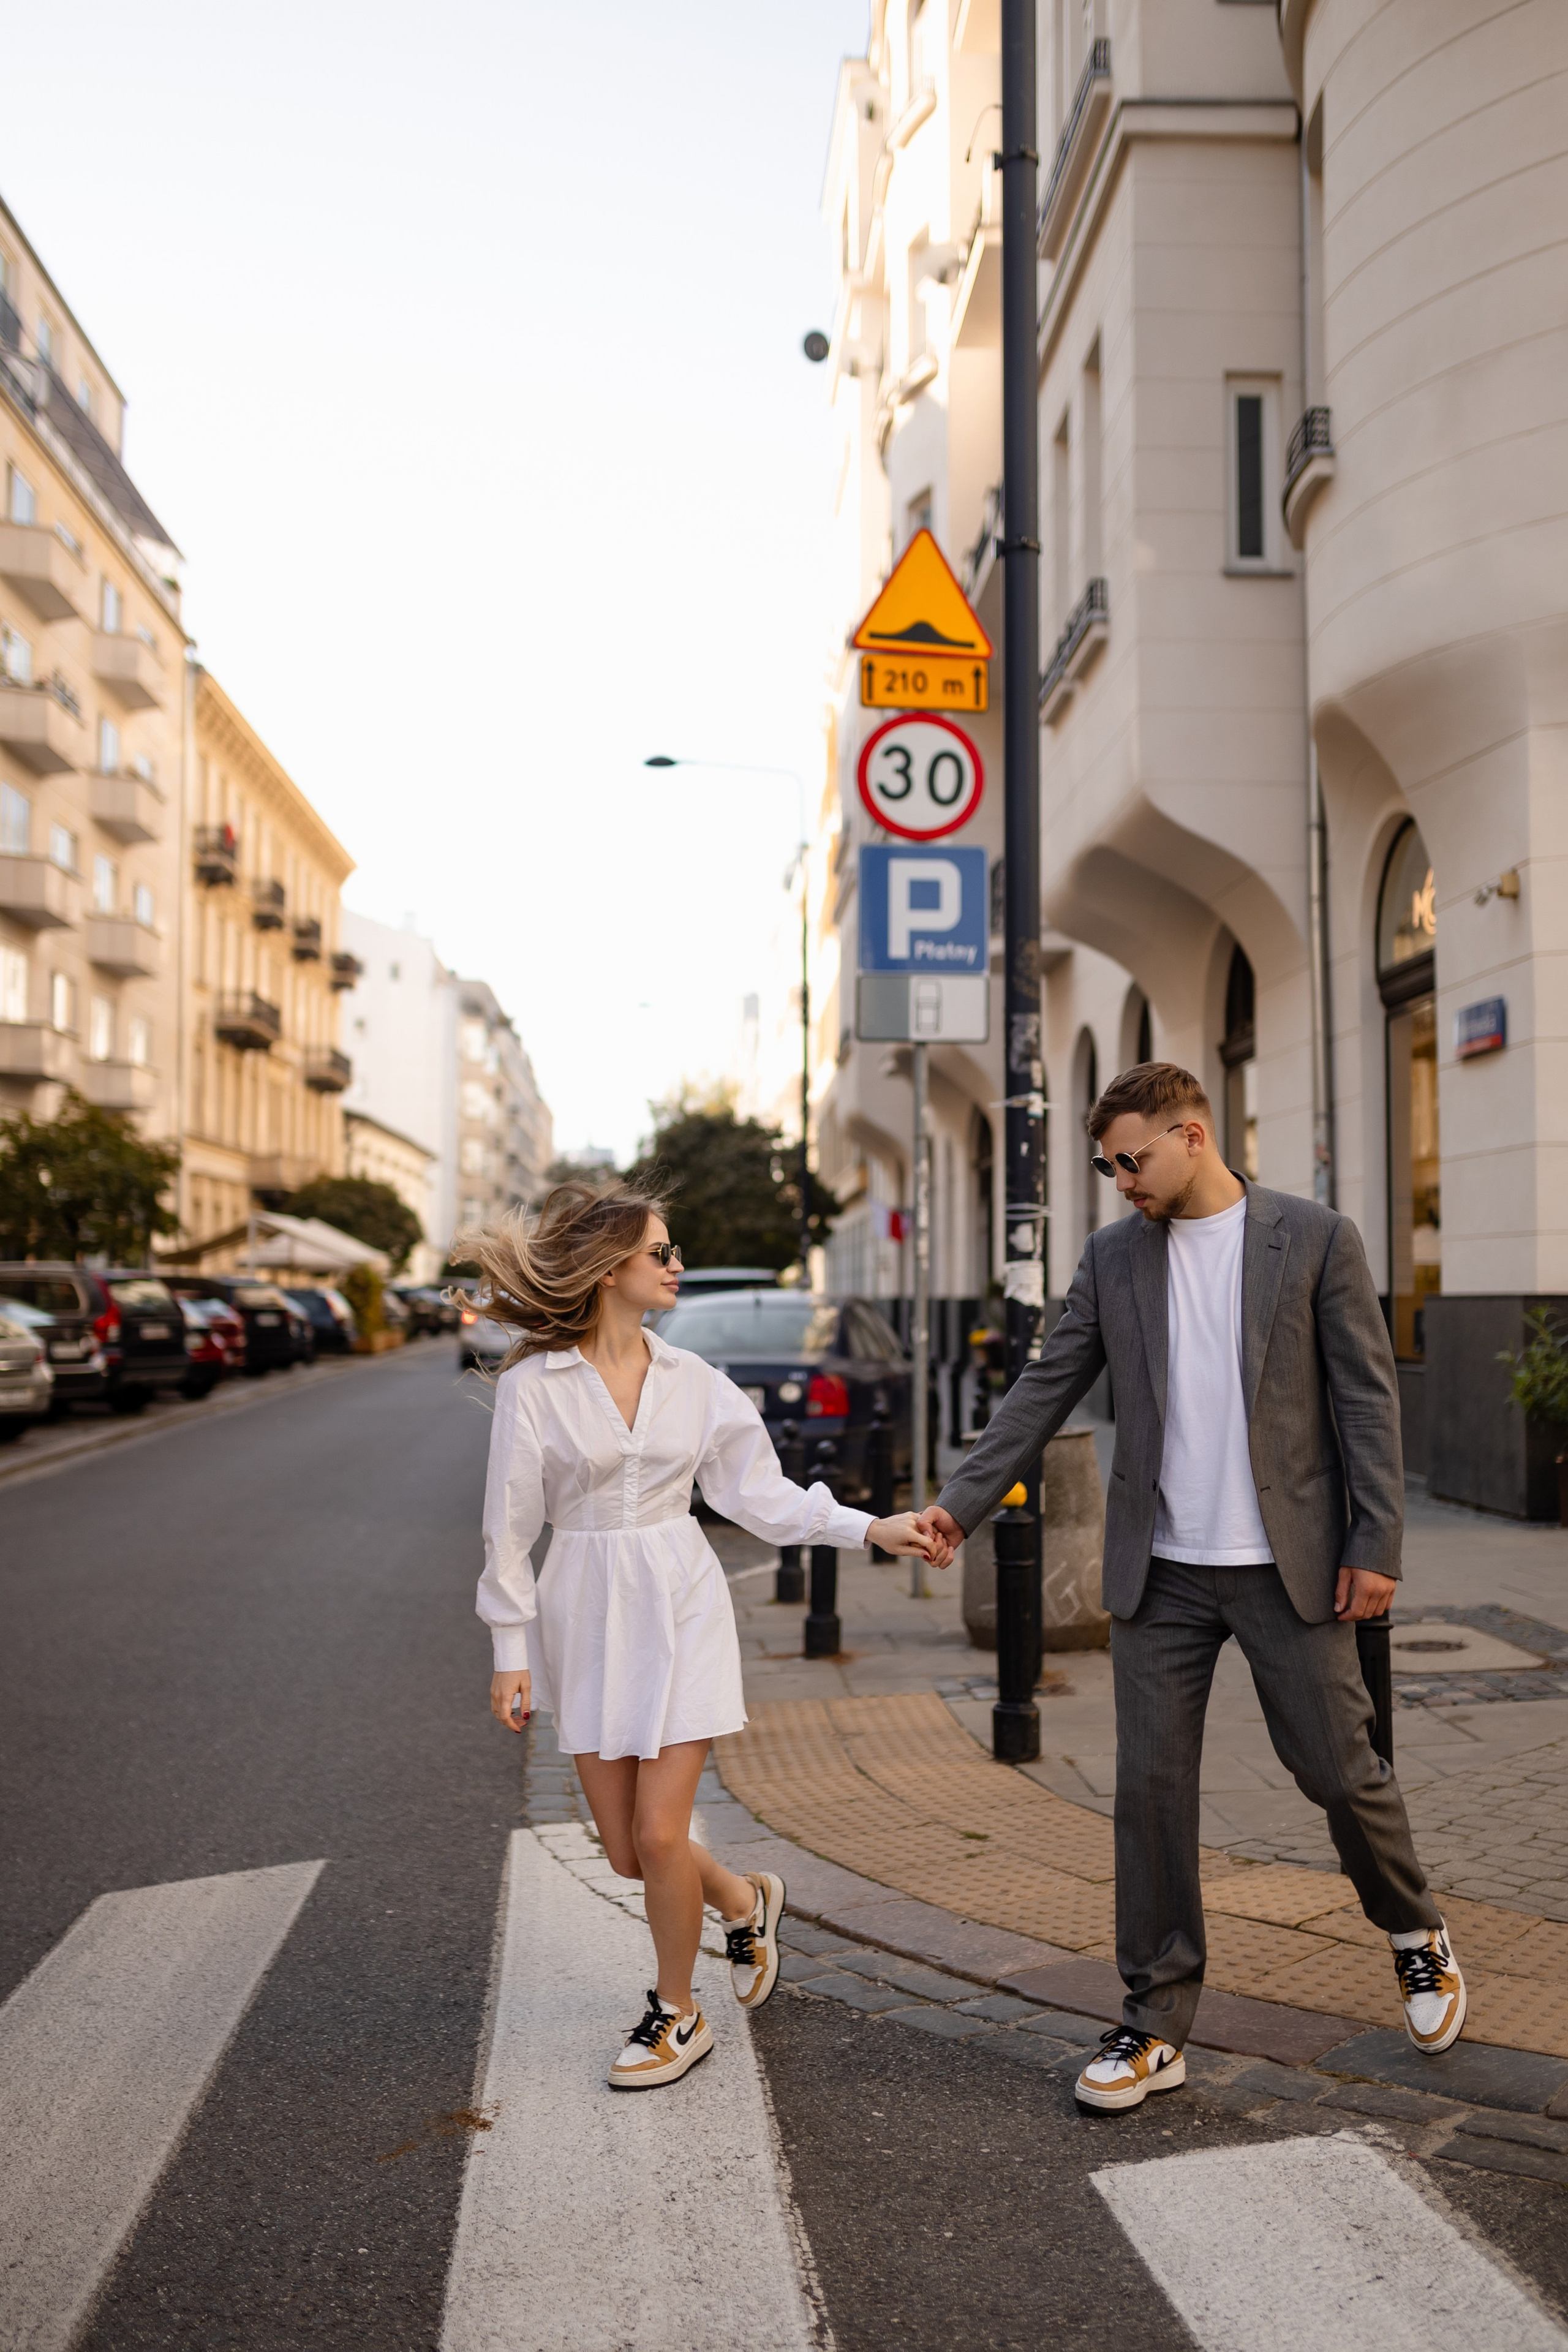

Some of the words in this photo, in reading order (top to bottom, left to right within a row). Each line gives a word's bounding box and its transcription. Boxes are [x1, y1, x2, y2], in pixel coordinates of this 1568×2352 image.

[884, 669, 928, 694] 210
[942, 679, 964, 695] m
[878, 745, 964, 806] 30
[888, 858, 962, 960] P
